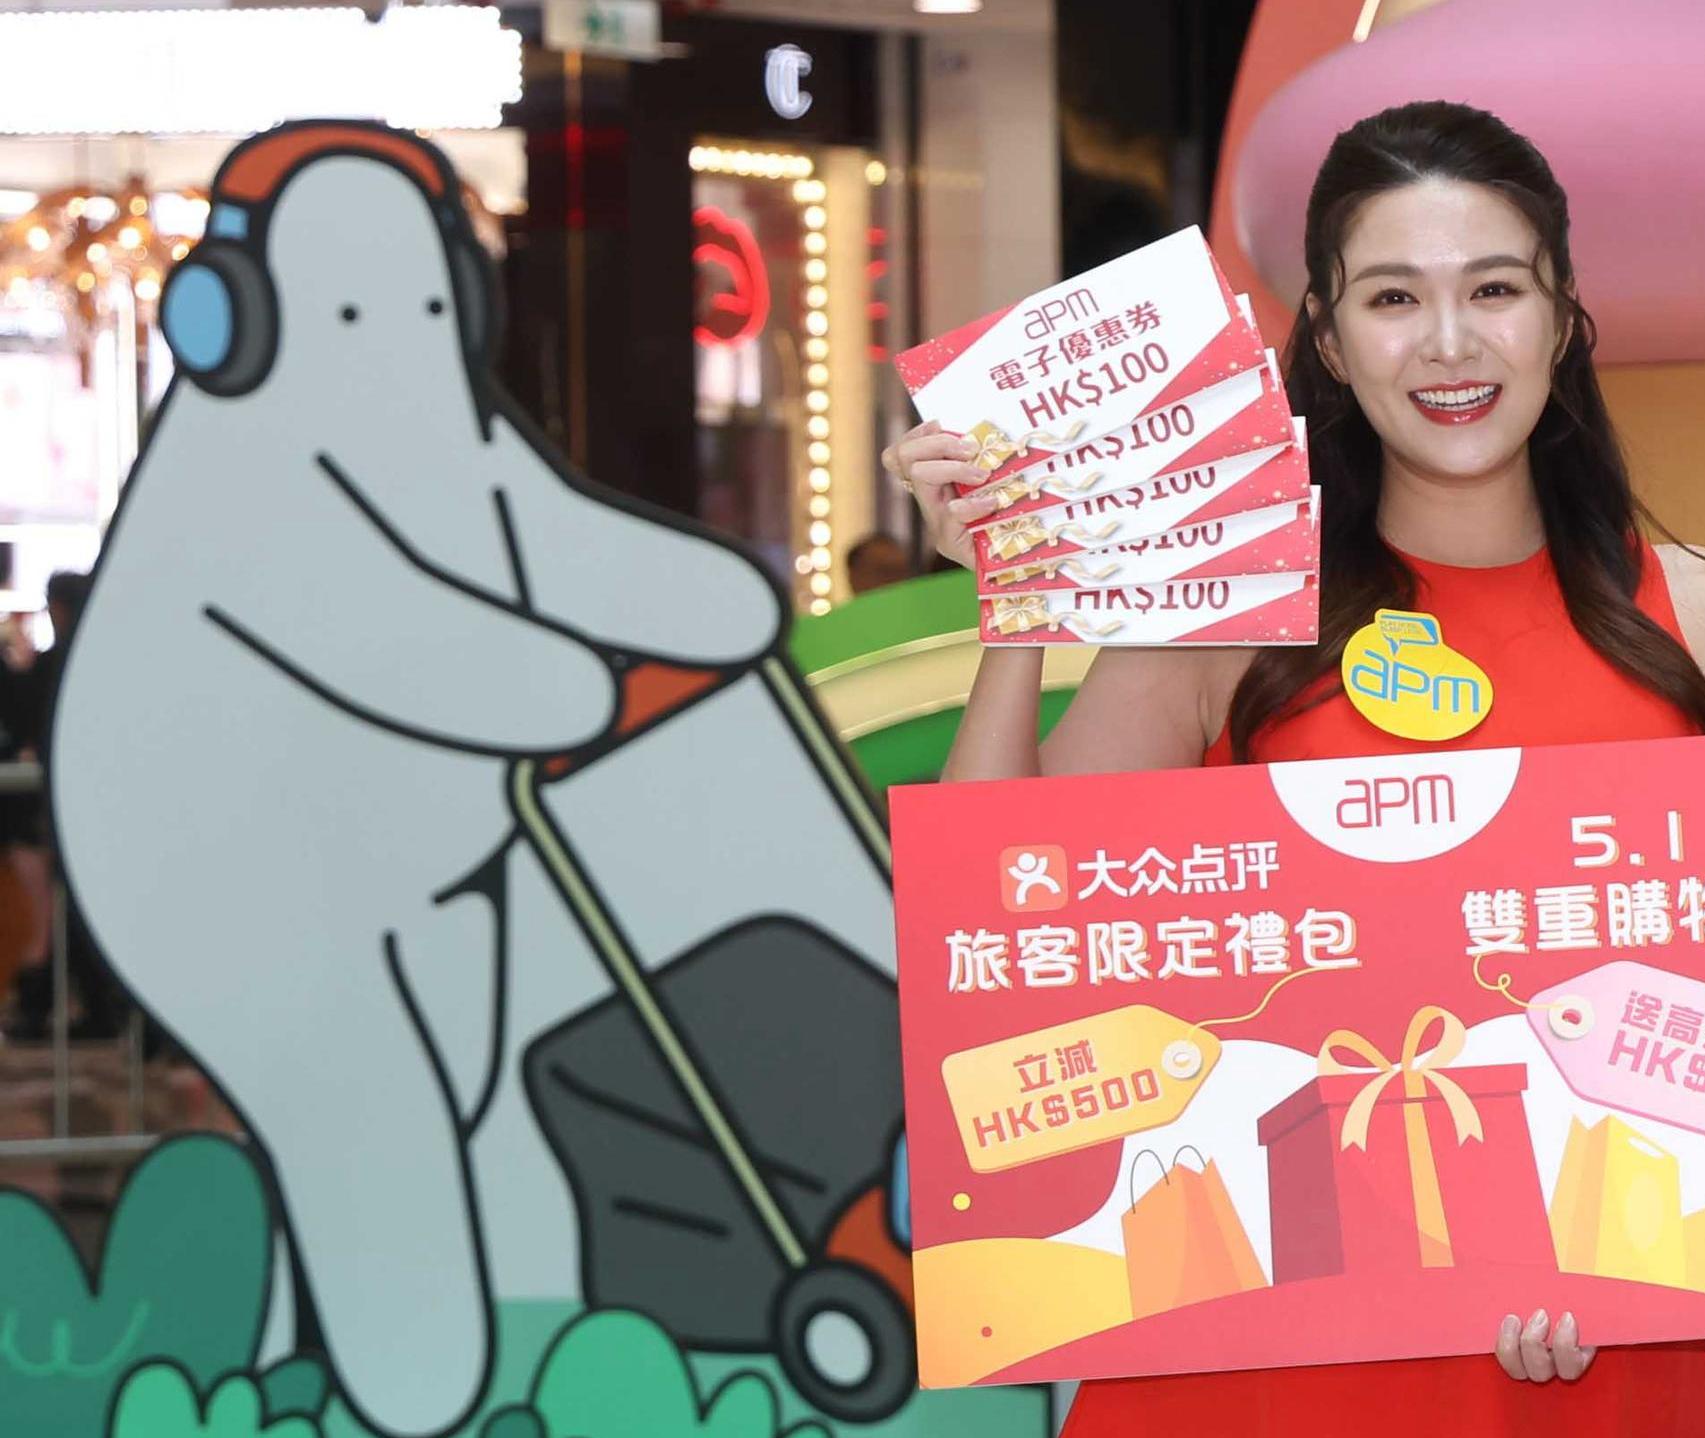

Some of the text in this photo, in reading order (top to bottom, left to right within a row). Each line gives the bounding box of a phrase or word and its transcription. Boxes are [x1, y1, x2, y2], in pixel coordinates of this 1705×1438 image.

[989, 300, 1161, 390] 電子優惠券
[1020, 342, 1169, 428] HK$100
[1077, 842, 1280, 896] 大众点评
[946, 908, 1361, 994] 旅客限定禮包
[973, 1068, 1160, 1148] HK$500
